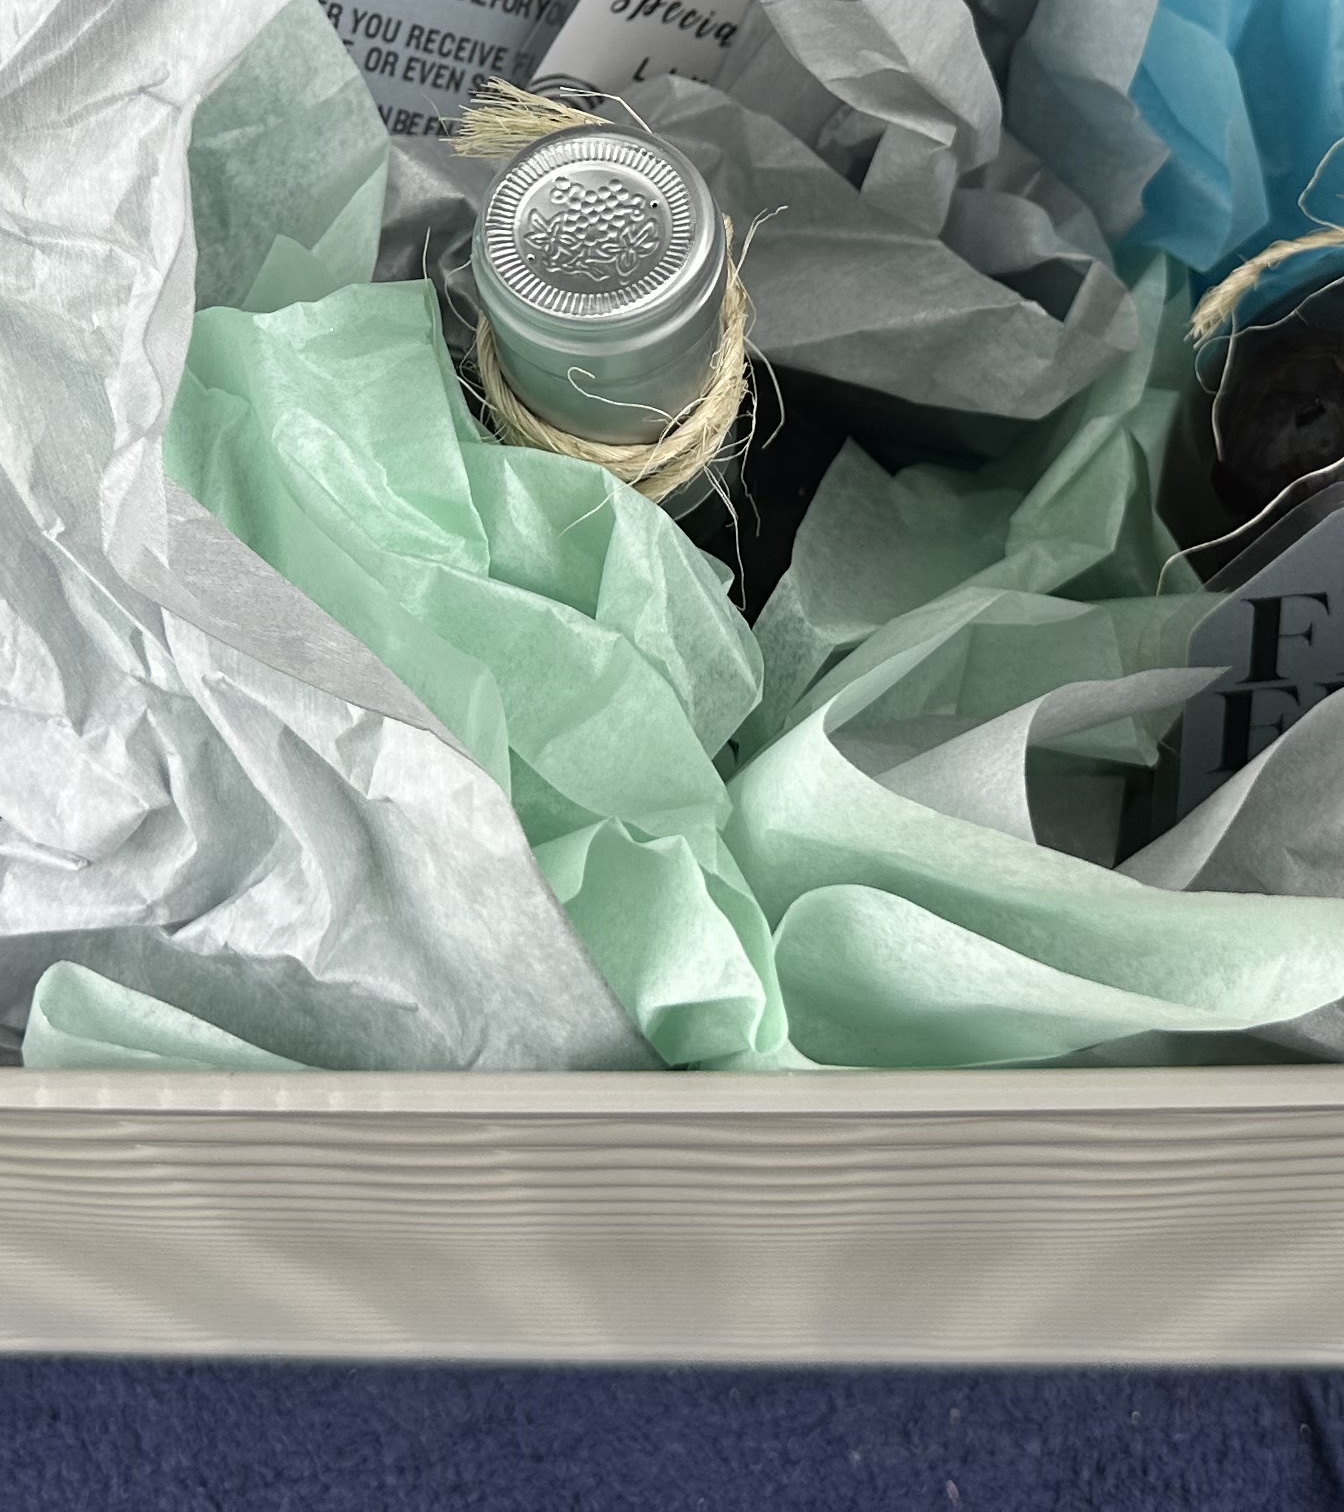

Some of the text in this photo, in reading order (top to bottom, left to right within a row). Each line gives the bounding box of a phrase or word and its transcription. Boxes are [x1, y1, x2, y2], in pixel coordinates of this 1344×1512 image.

[351, 7, 402, 44] YOU
[405, 24, 509, 72] RECEIVE
[364, 47, 399, 77] OR
[402, 57, 466, 94] EVEN
[392, 108, 424, 135] BE
